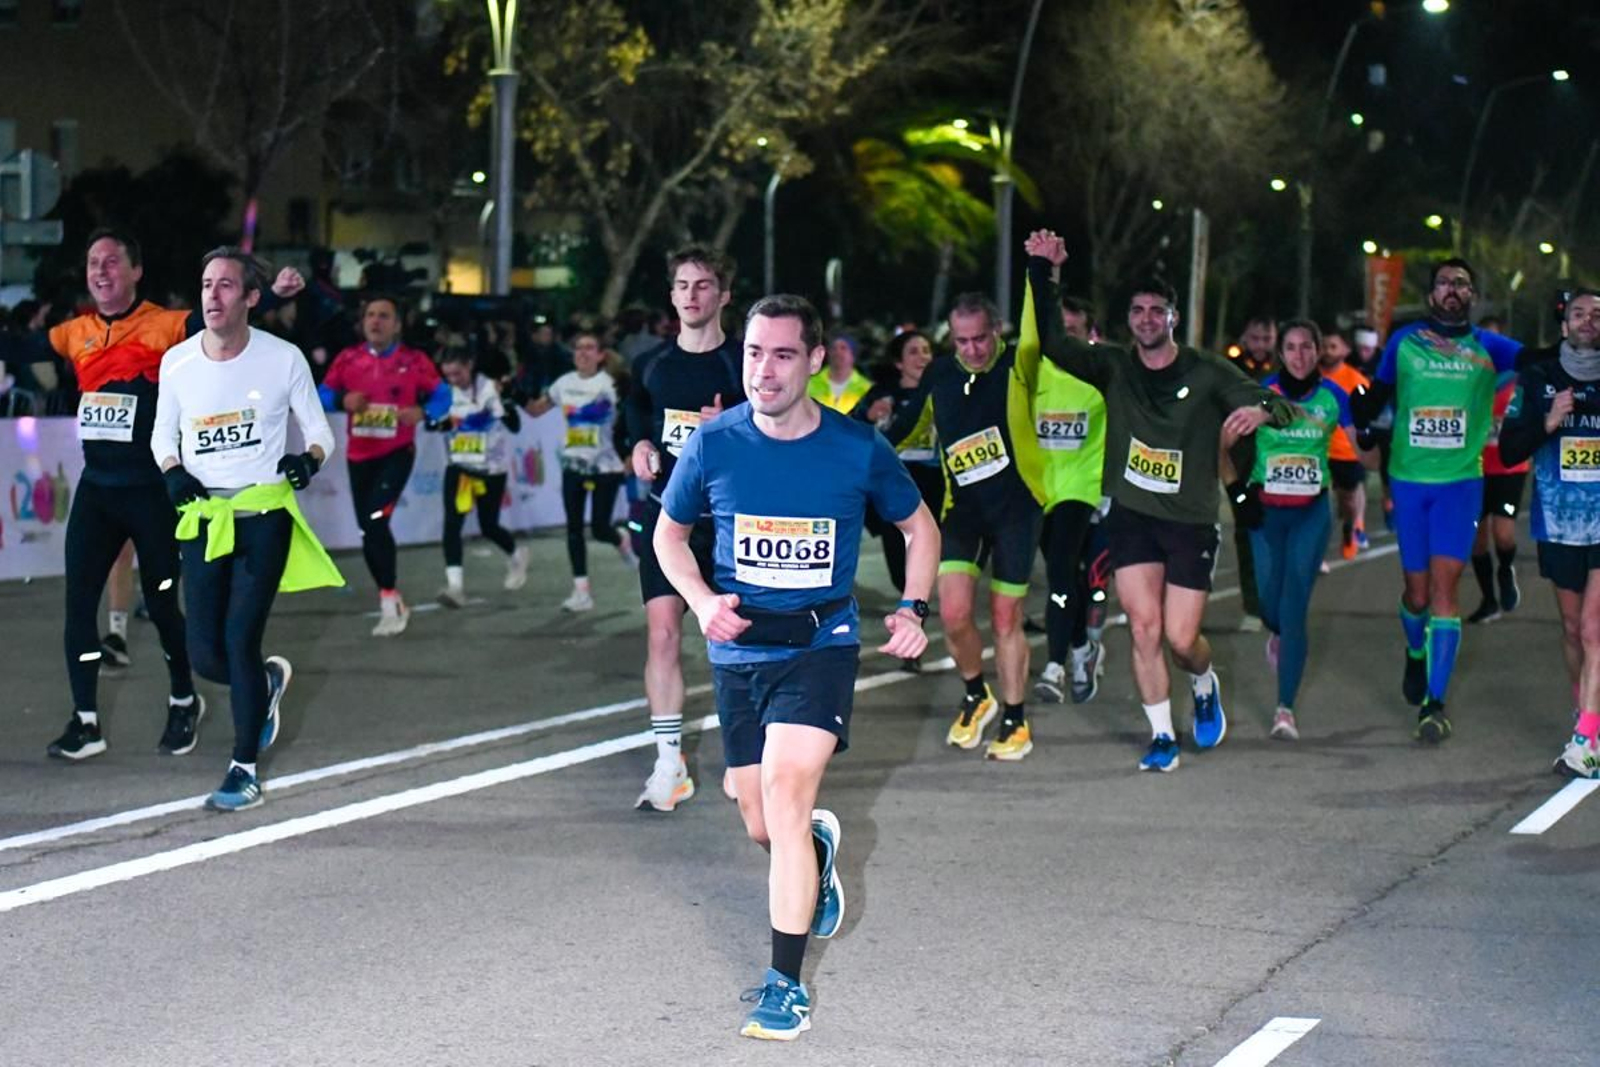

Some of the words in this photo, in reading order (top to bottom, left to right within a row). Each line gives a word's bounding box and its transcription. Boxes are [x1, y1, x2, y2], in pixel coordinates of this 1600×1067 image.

[83, 406, 129, 422] 5102
[198, 422, 254, 448] 5457
[1040, 420, 1084, 436] 6270
[1415, 419, 1461, 433] 5389
[954, 442, 998, 468] 4190
[1131, 454, 1176, 478] 4080
[1272, 466, 1318, 481] 5506
[739, 536, 830, 561] 10068
